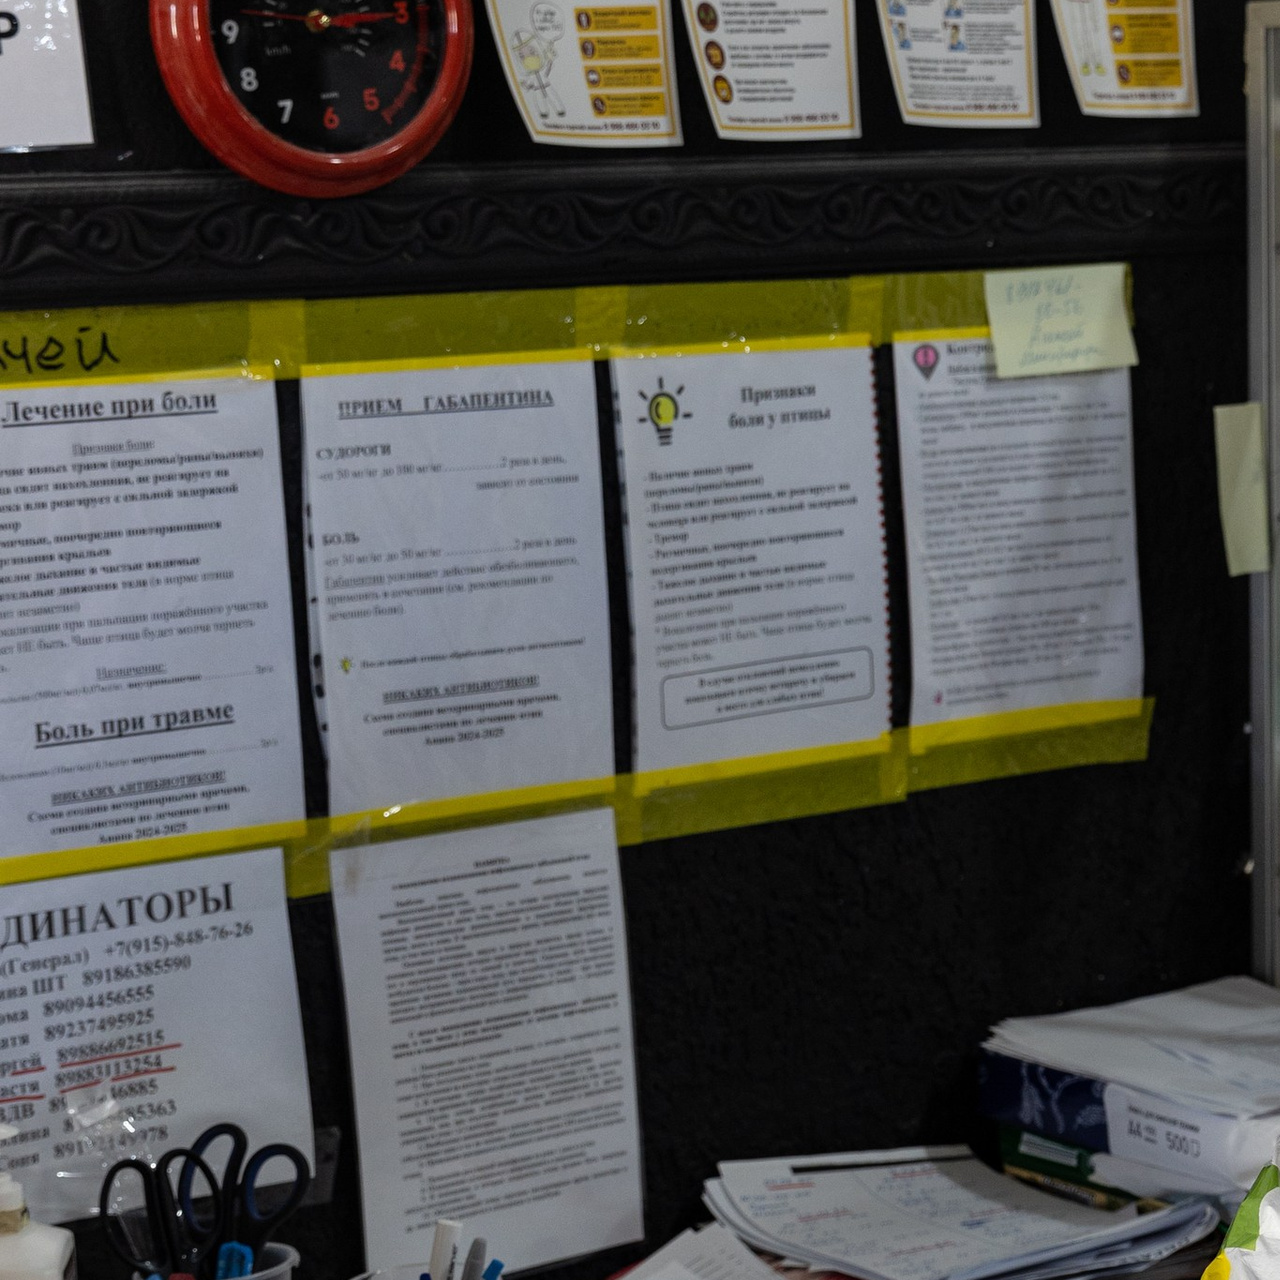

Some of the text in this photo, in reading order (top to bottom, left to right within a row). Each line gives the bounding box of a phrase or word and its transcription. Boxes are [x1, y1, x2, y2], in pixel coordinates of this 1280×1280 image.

[393, 1, 409, 24] 3
[222, 20, 239, 44] 9
[389, 50, 405, 72] 4
[240, 68, 258, 91] 8
[277, 98, 293, 124] 7
[363, 88, 379, 111] 5
[323, 106, 340, 129] 6
[0, 324, 119, 372] чей
[338, 389, 554, 417] ПРИЕМ ГАБАПЕНТИНА
[741, 384, 816, 406] Признаки
[1, 391, 217, 423] Лечение при боли
[729, 411, 765, 428] боли
[781, 407, 831, 424] птицы
[316, 444, 391, 460] СУДОРОГИ
[35, 704, 234, 743] Боль при травме
[0, 881, 234, 950] ДИНАТОРЫ
[32, 974, 68, 995] ШТ
